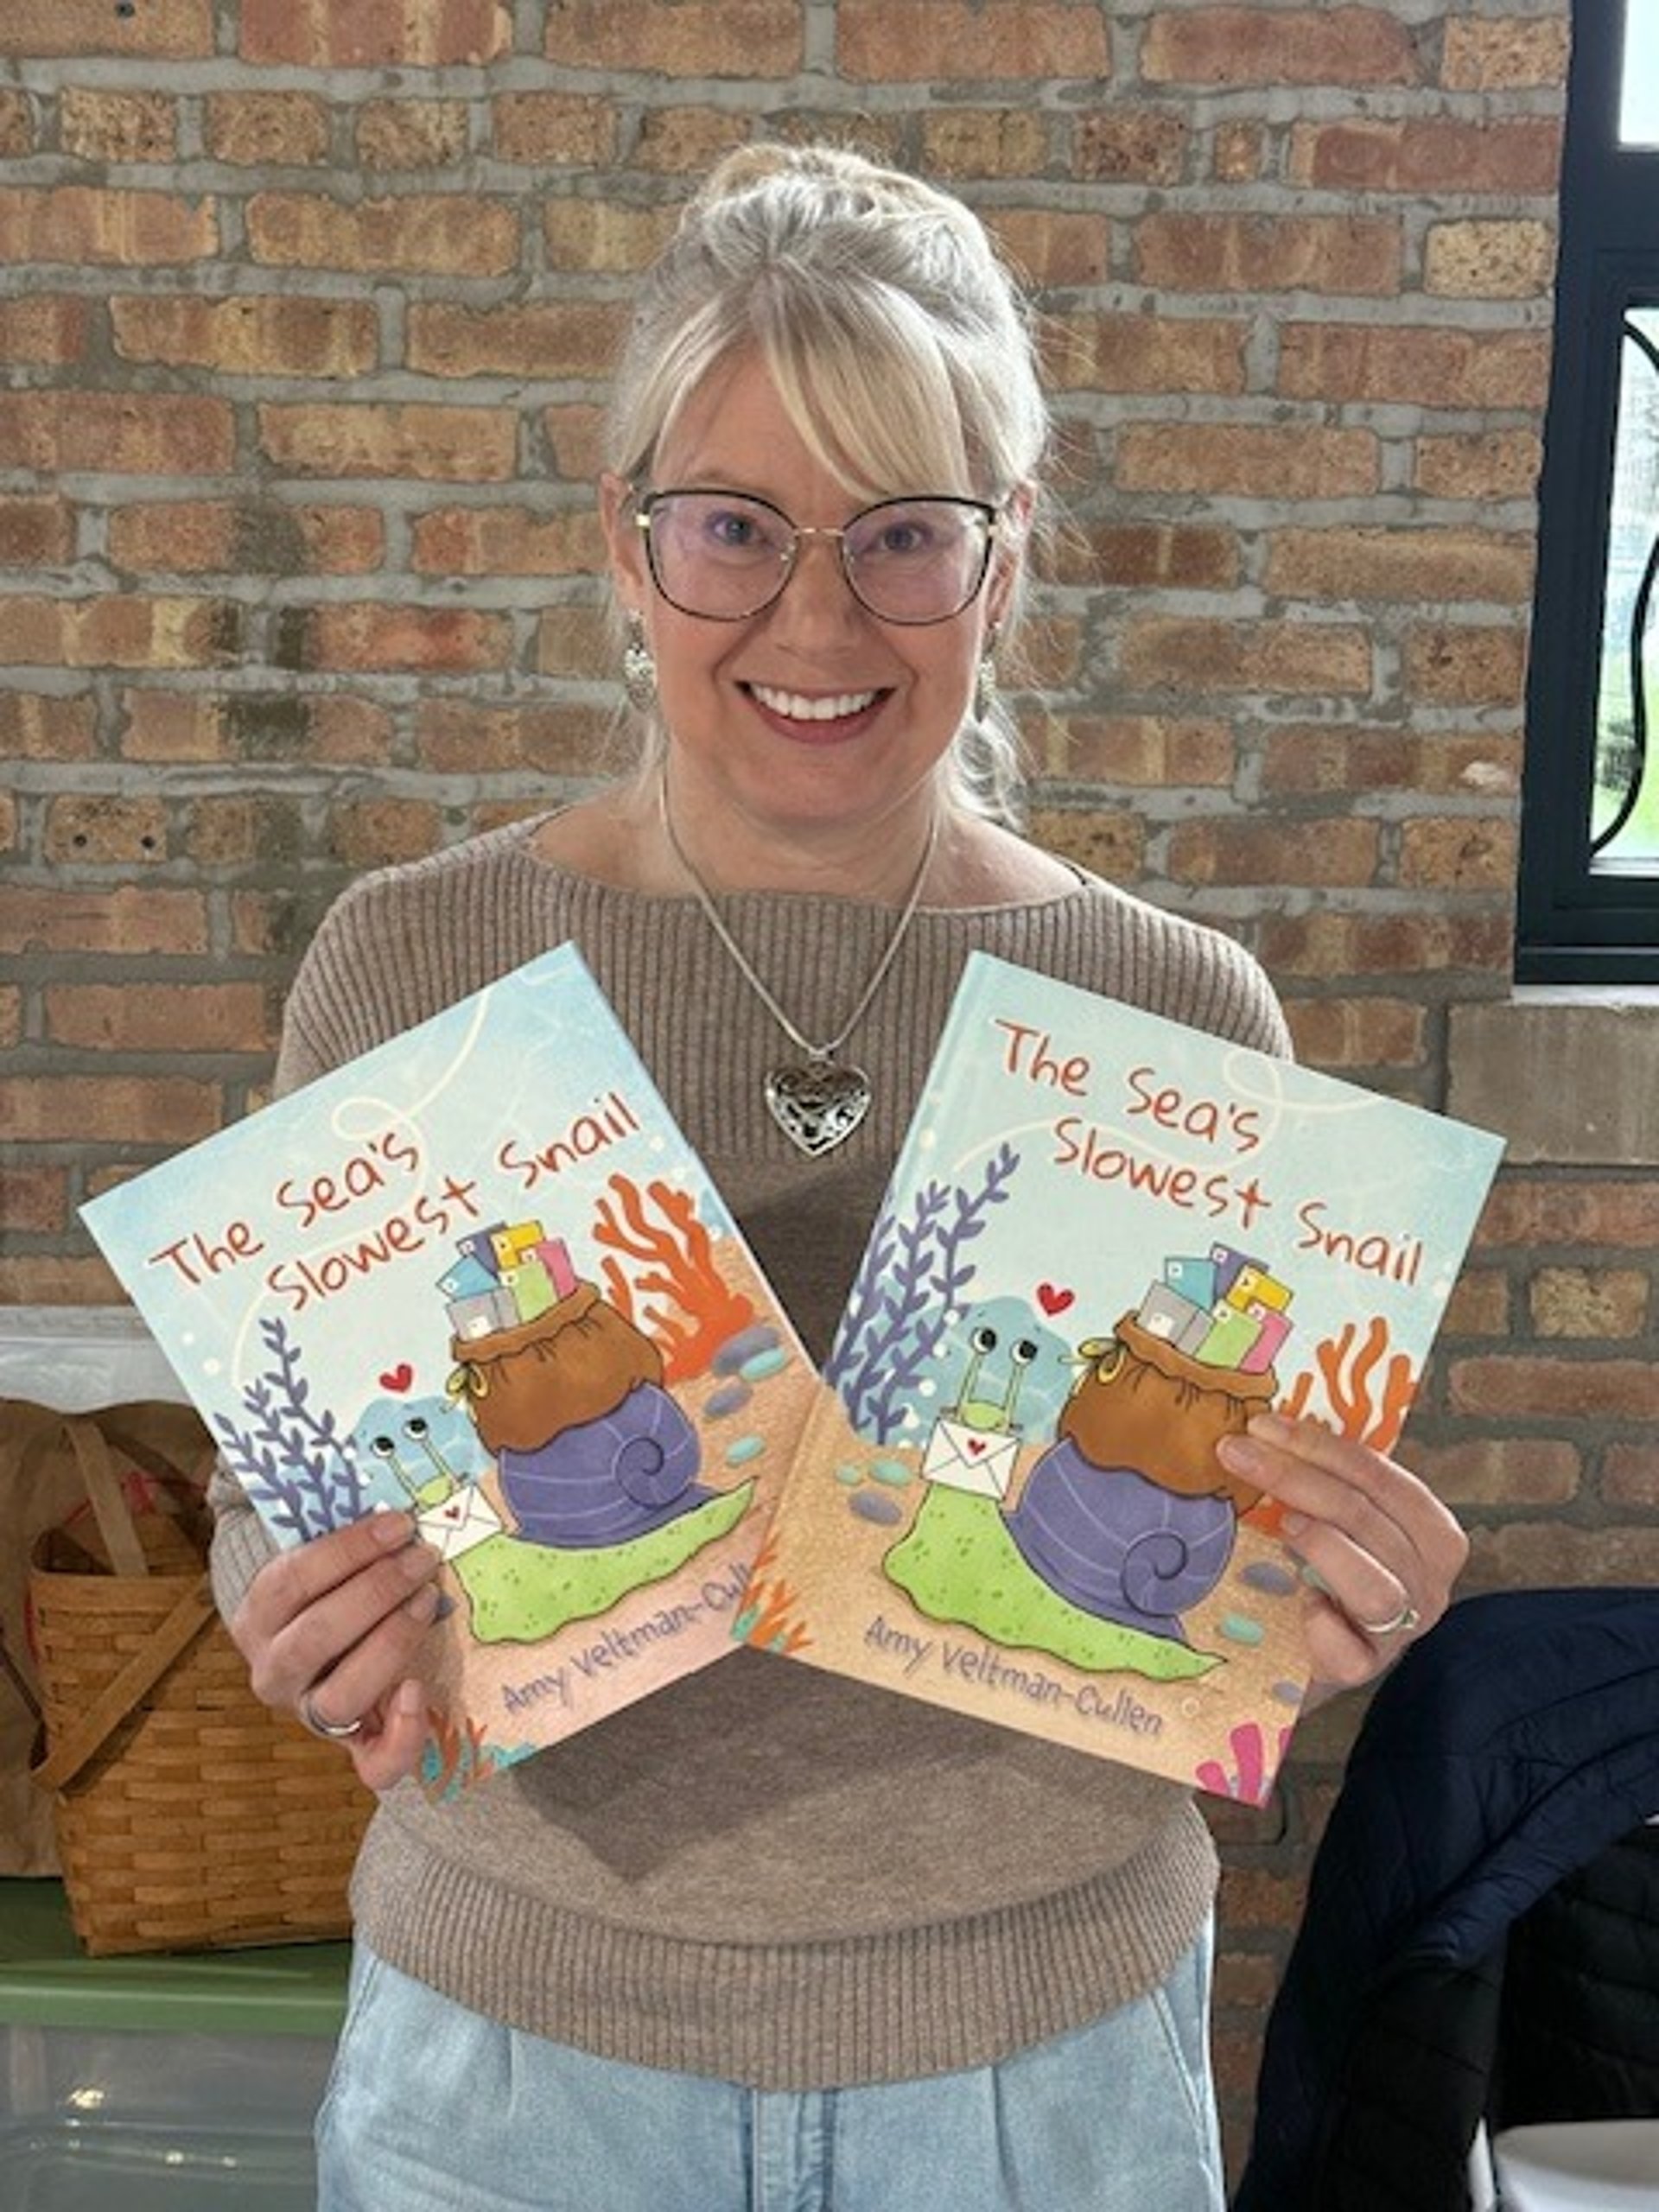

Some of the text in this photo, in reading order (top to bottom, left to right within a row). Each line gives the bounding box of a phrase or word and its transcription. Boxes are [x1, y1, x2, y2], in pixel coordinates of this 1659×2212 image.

[995, 1018, 1261, 1152] The Sea's
[148, 1132, 420, 1285] The Sea's
[266, 1092, 640, 1311] Slowest Snail
[1053, 1117, 1423, 1287] Slowest Snail
[501, 1561, 754, 1714] Amy Veltman-Cull
[865, 1615, 1162, 1736] Amy Veltman-Cullen
